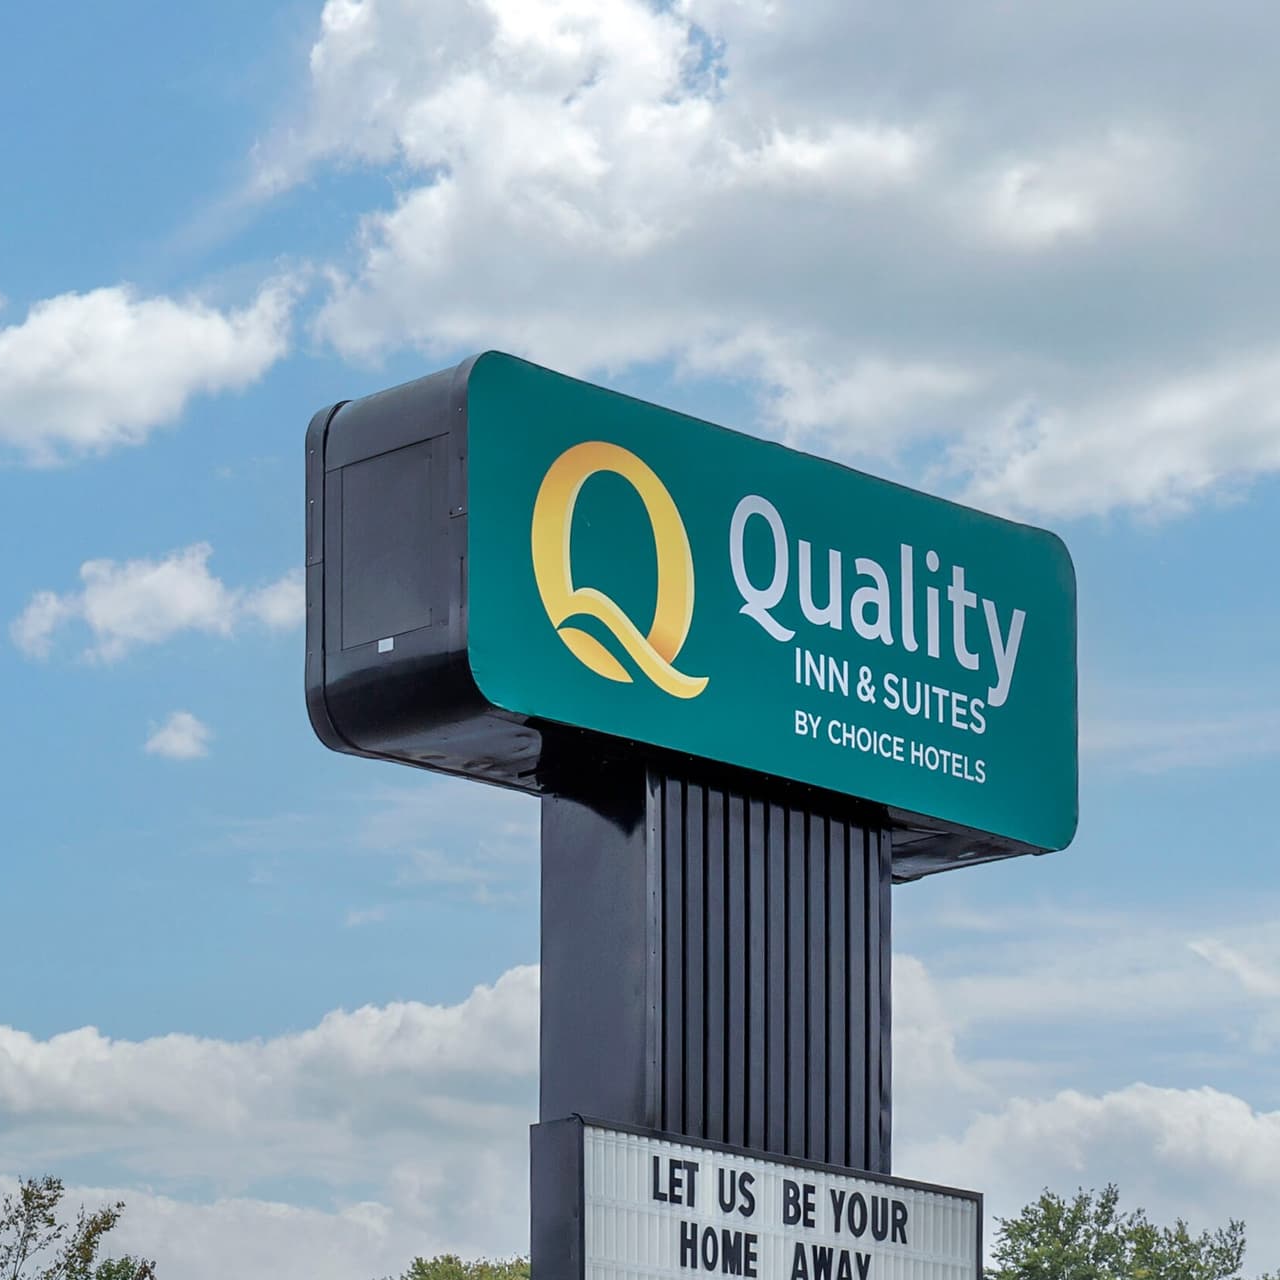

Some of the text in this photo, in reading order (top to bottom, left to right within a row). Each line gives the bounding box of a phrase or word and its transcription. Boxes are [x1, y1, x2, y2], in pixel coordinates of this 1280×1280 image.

[531, 441, 710, 699] Q
[729, 494, 1026, 706] Quality
[795, 647, 986, 734] INN & SUITES
[795, 710, 986, 784] BY CHOICE HOTELS
[652, 1155, 908, 1245] LET US BE YOUR
[680, 1220, 758, 1279] HOME
